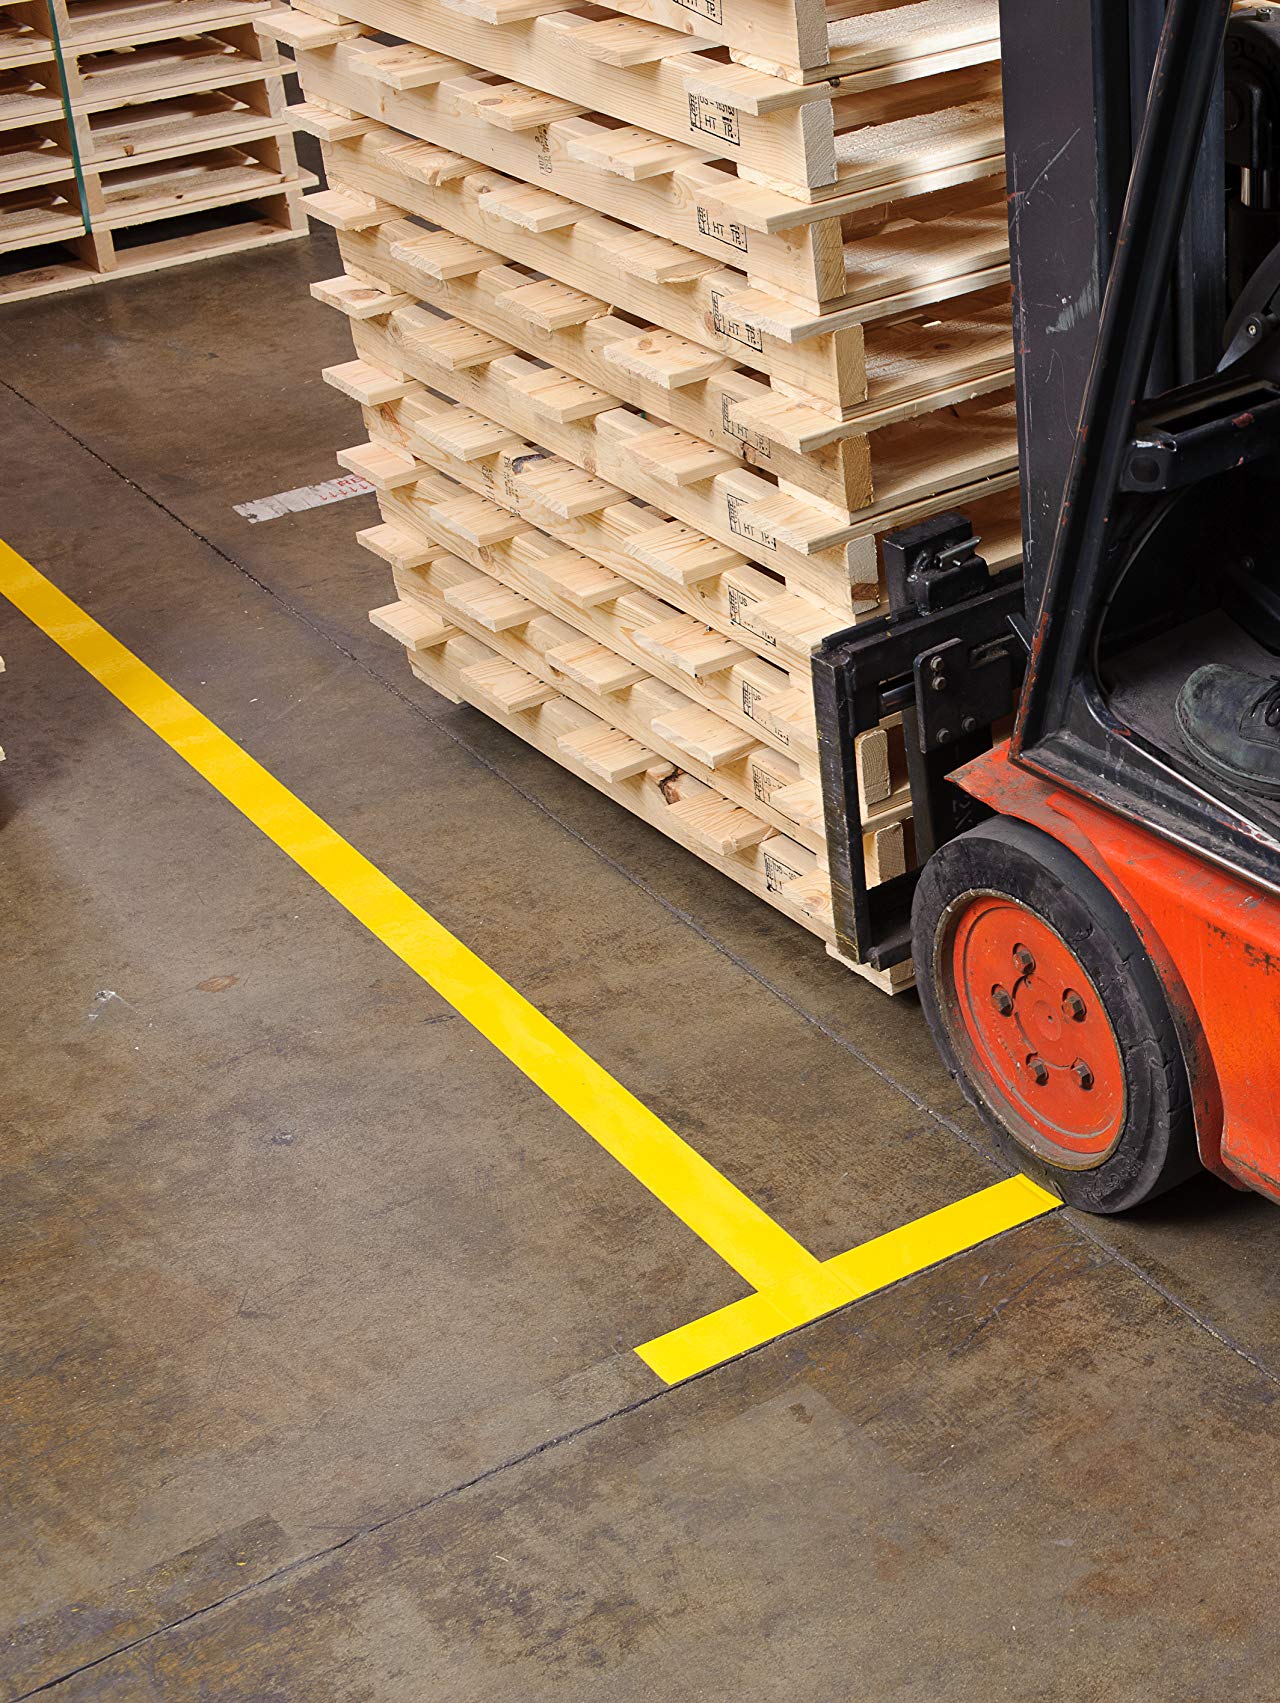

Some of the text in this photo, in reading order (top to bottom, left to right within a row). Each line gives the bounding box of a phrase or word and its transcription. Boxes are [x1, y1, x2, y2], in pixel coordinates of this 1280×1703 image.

[704, 114, 717, 130] HT
[712, 220, 724, 236] HT
[728, 320, 740, 336] HT
[737, 423, 748, 439] HT
[743, 523, 754, 537] HT
